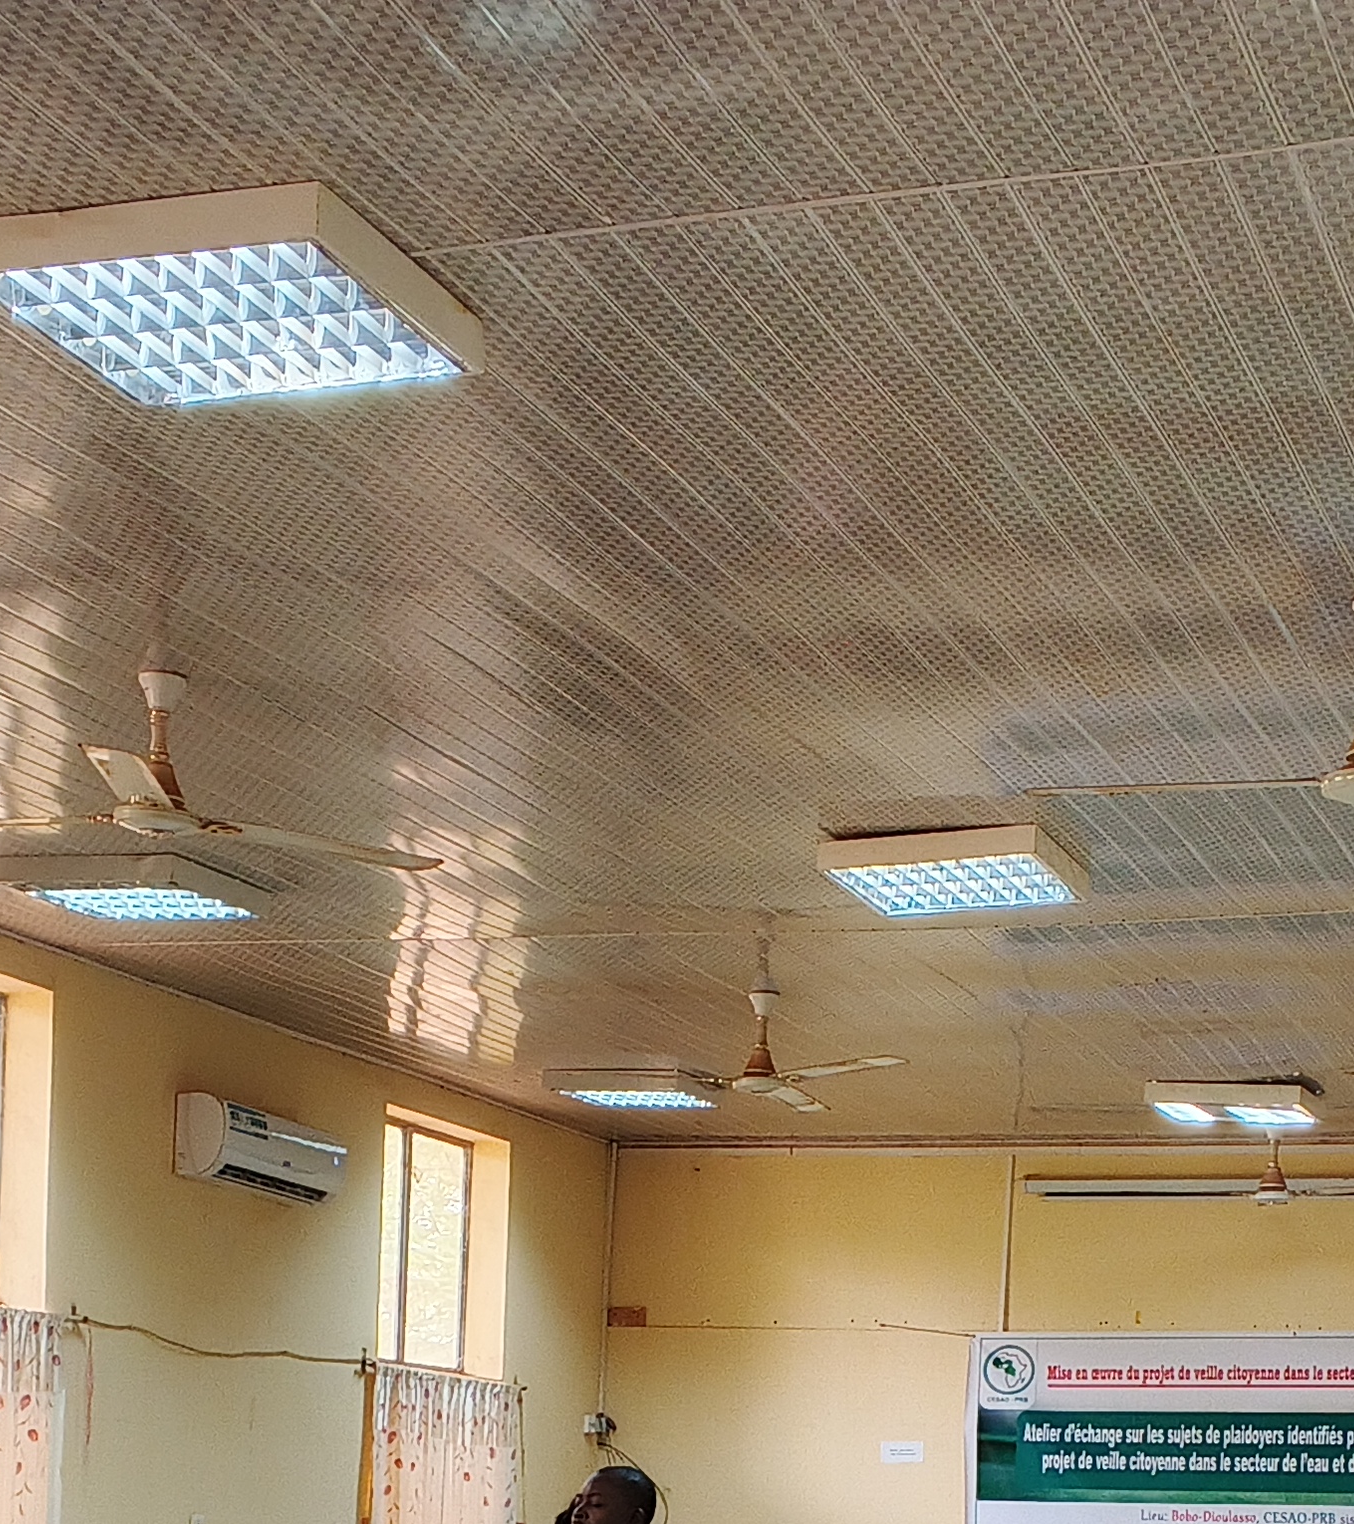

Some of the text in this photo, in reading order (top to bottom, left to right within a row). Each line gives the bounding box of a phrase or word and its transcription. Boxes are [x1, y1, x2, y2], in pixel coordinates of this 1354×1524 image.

[1047, 1364, 1072, 1380] Mise
[1075, 1367, 1088, 1380] en
[1091, 1367, 1123, 1380] œuvre
[1126, 1365, 1140, 1380] du
[1142, 1364, 1175, 1384] projet
[1178, 1365, 1191, 1380] de
[1193, 1365, 1224, 1380] veille
[1226, 1364, 1280, 1384] citoyenne
[1283, 1365, 1310, 1380] dans
[1312, 1365, 1323, 1380] le
[1023, 1422, 1062, 1442] Atelier
[1064, 1423, 1123, 1448] d'échange
[1125, 1428, 1145, 1443] sur
[1146, 1424, 1165, 1444] les
[1167, 1424, 1203, 1448] sujets
[1205, 1424, 1221, 1444] de
[1223, 1424, 1284, 1449] plaidoyers
[1287, 1425, 1344, 1445] identifiés
[1041, 1450, 1075, 1474] projet
[1078, 1450, 1093, 1469] de
[1096, 1450, 1127, 1470] veille
[1129, 1451, 1187, 1475] citoyenne
[1189, 1452, 1217, 1471] dans
[1219, 1452, 1232, 1471] le
[1234, 1453, 1280, 1472] secteur
[1282, 1452, 1298, 1472] de
[1300, 1453, 1330, 1473] l'eau
[1332, 1454, 1346, 1473] et
[1171, 1509, 1260, 1524] Bobo-Dioulasso,
[1263, 1511, 1336, 1524] CESAO-PRB
